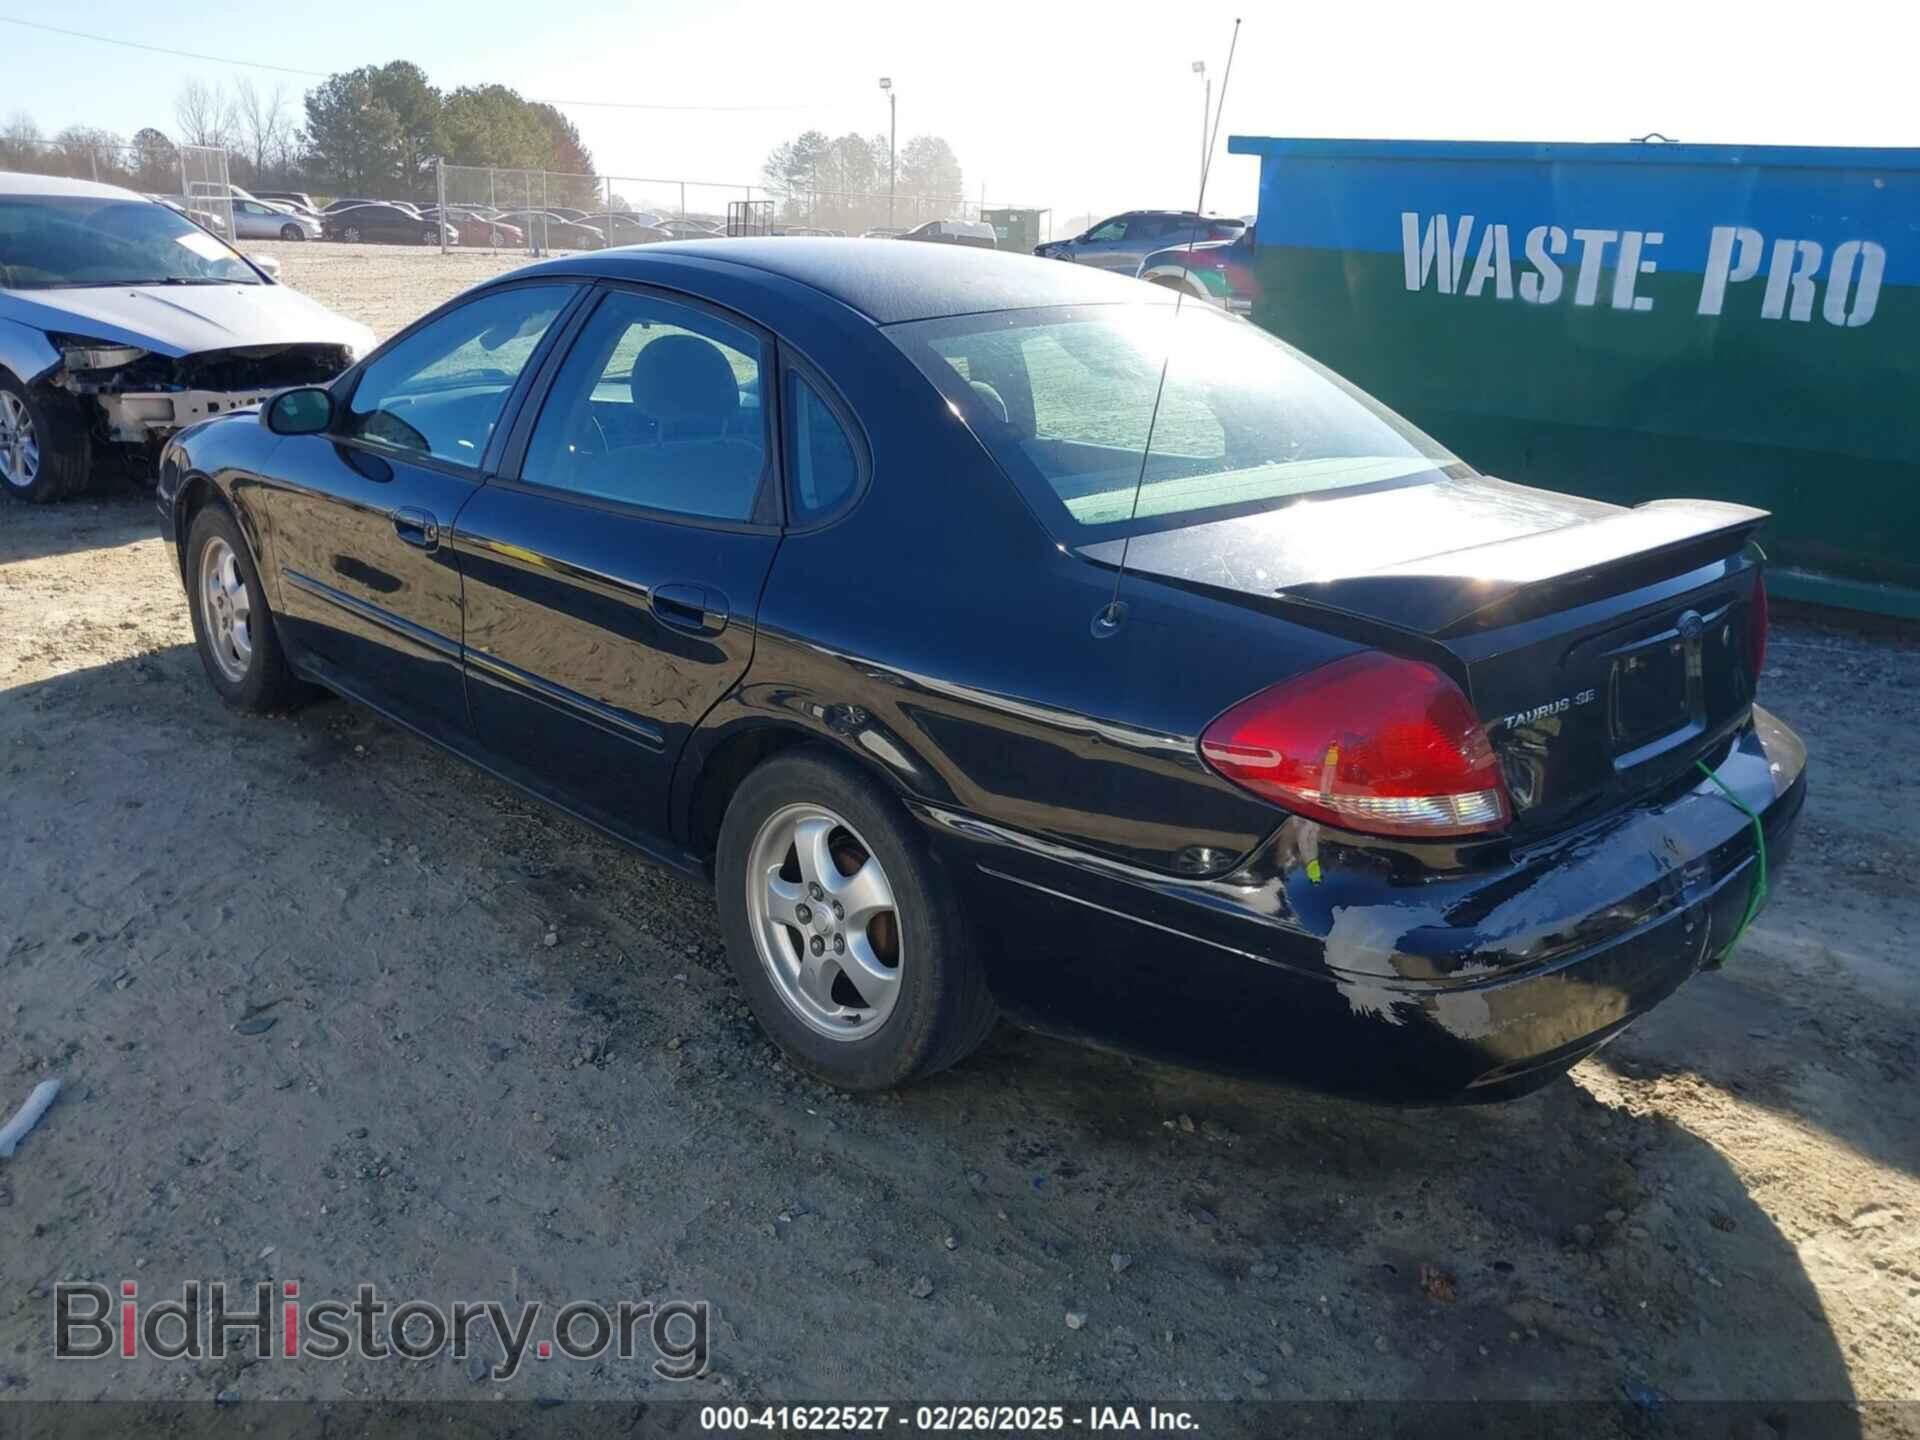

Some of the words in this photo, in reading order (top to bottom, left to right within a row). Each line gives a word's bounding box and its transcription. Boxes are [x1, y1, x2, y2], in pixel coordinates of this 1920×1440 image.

[1401, 212, 1664, 311] WASTE
[1698, 226, 1886, 328] PRO
[1504, 697, 1570, 729] TAURUS
[1575, 689, 1596, 706] SE
